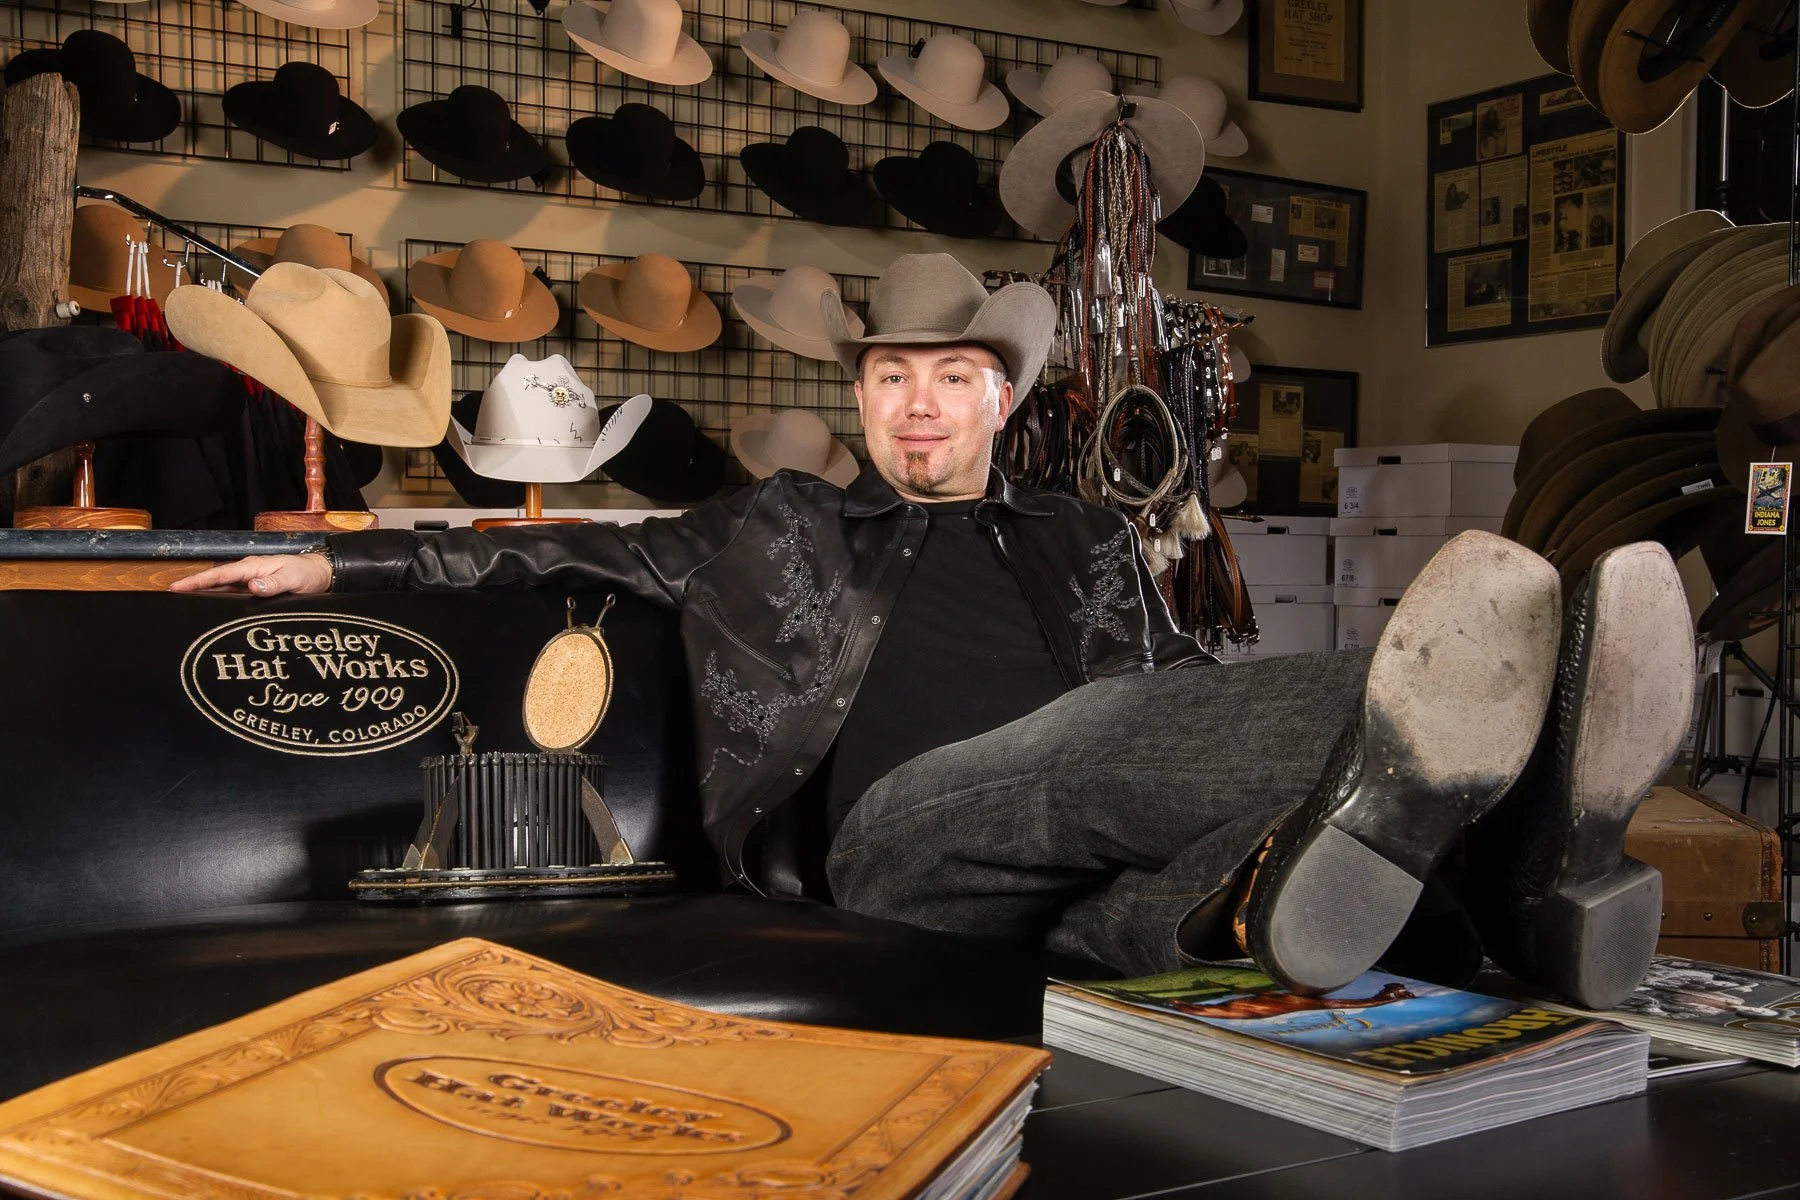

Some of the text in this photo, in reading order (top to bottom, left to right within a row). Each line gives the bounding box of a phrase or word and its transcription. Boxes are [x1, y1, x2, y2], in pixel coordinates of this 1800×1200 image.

[1284, 8, 1334, 24] HAT SHOP
[1754, 511, 1781, 519] INDIANA
[246, 627, 381, 657] Greeley
[212, 652, 430, 680] Hat Works
[248, 682, 405, 713] Since 1909
[232, 704, 428, 745] GREELEY, COLORADO
[404, 1068, 529, 1108] Hat
